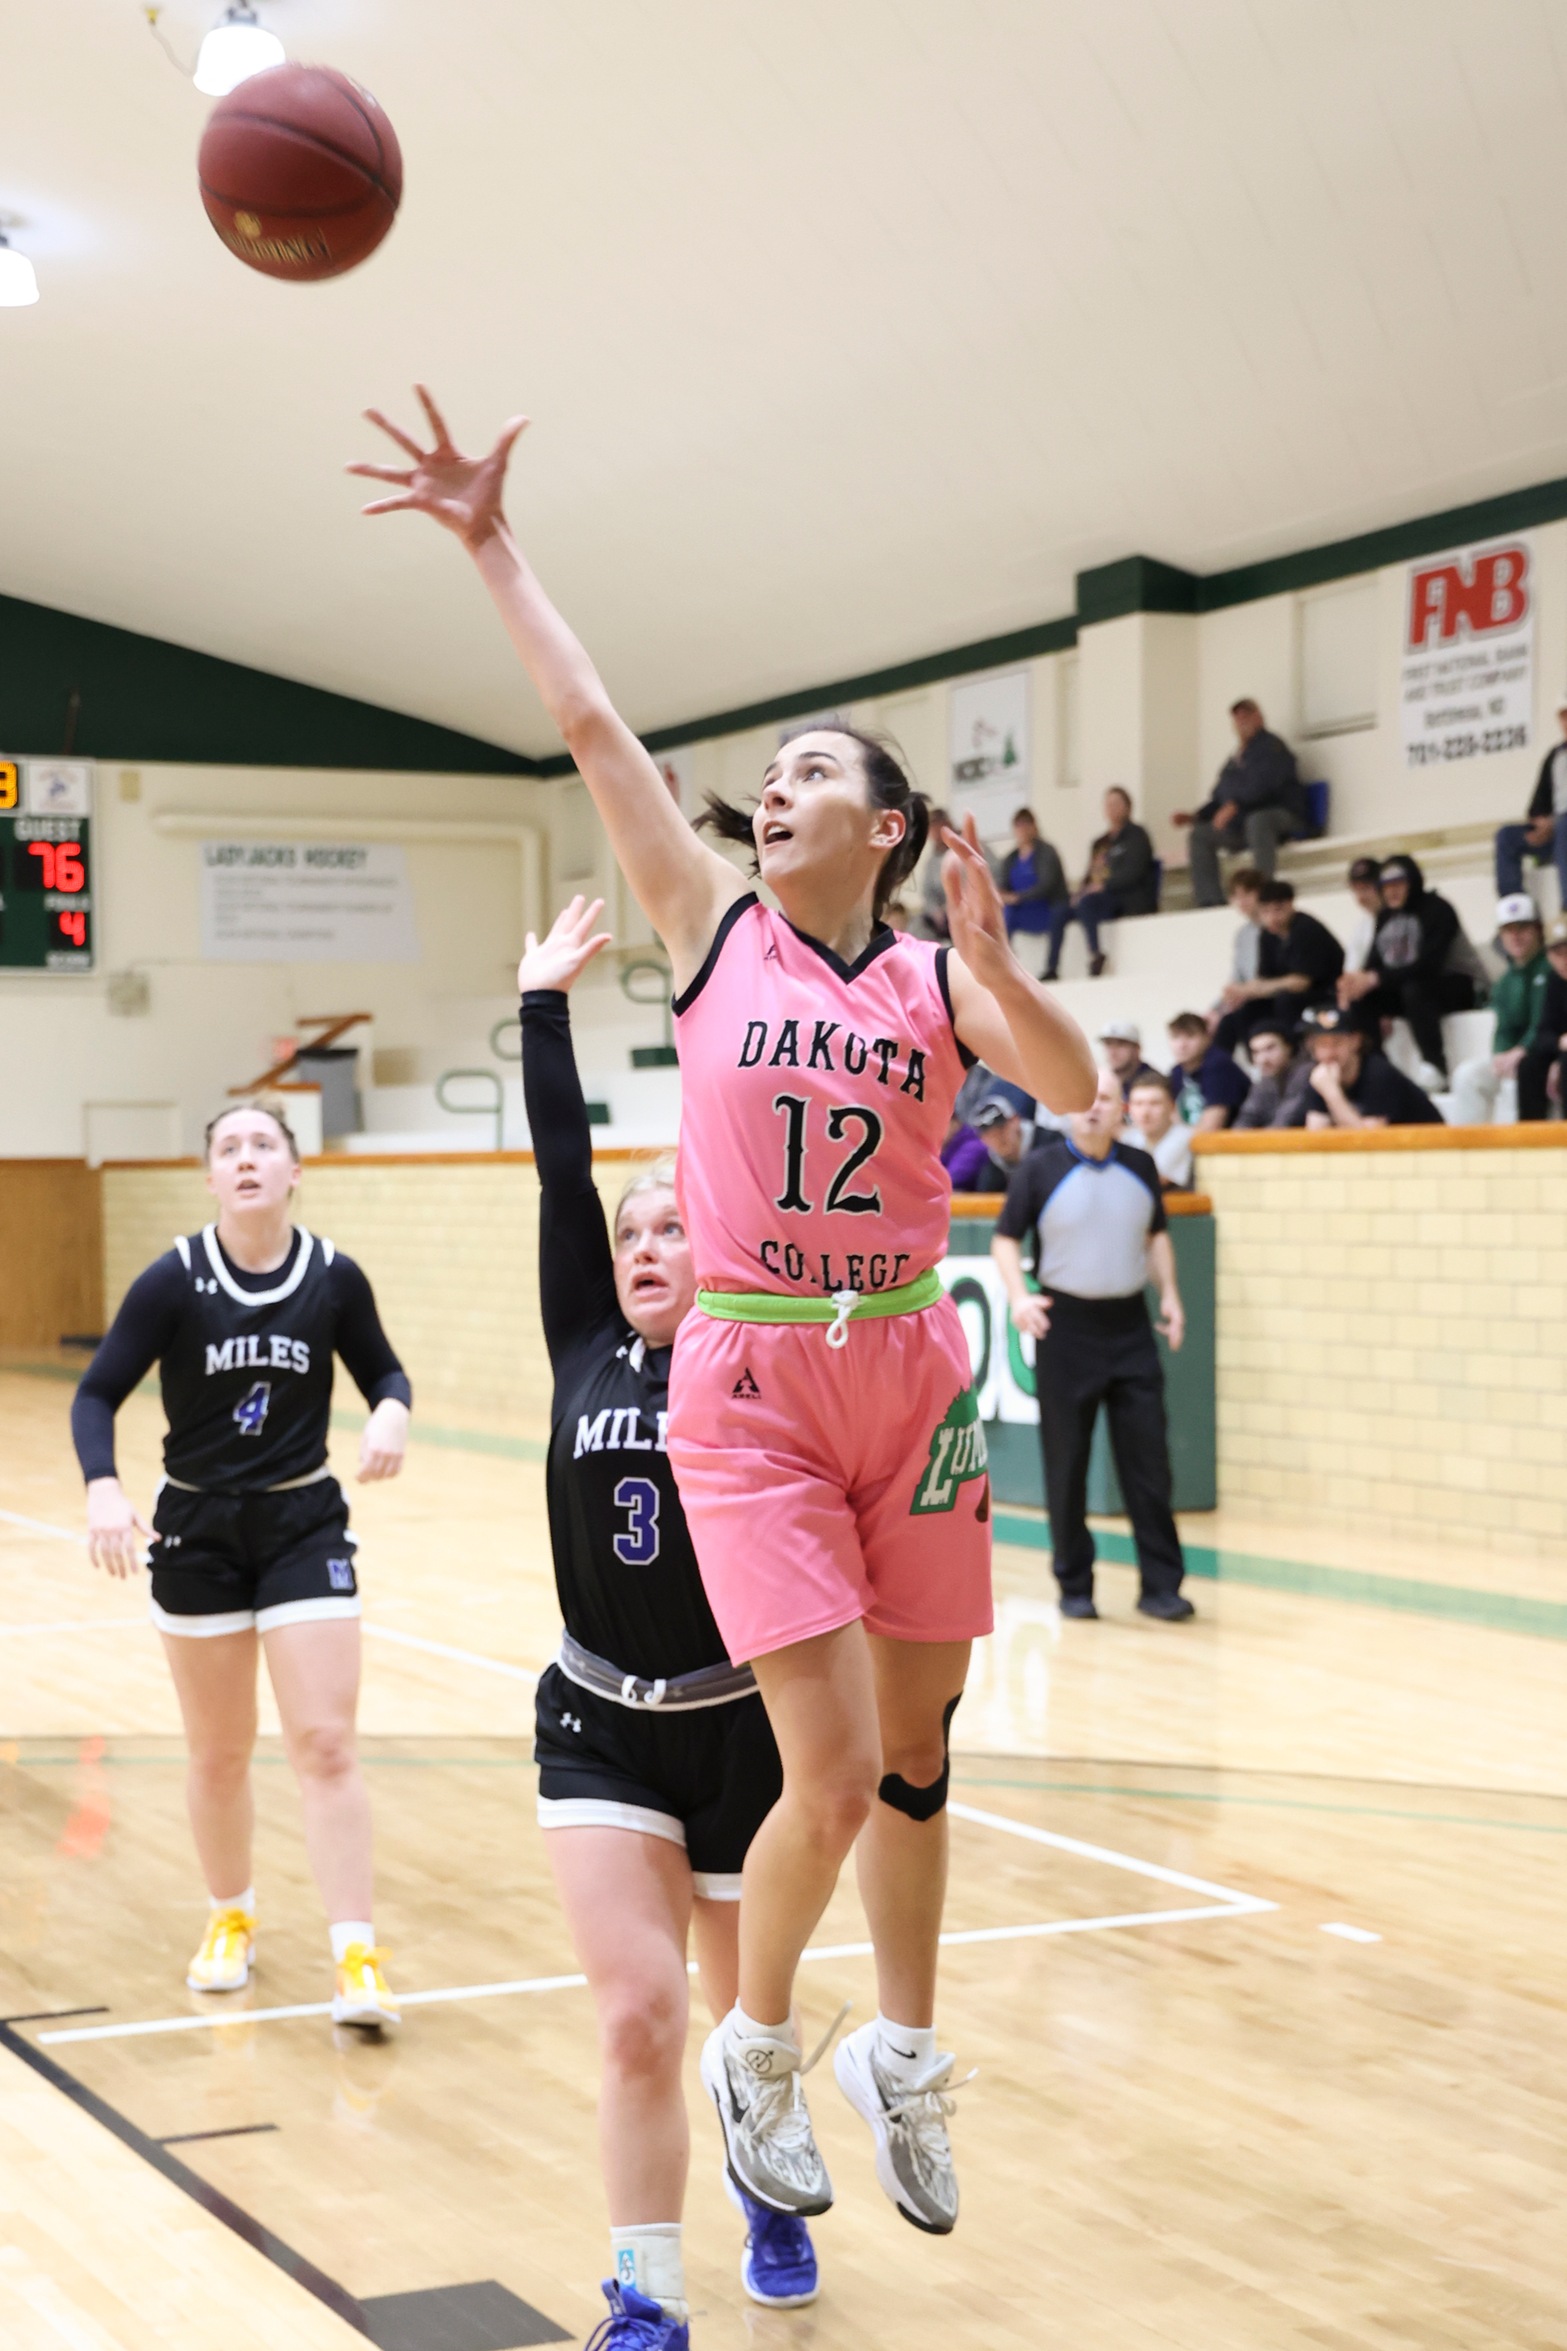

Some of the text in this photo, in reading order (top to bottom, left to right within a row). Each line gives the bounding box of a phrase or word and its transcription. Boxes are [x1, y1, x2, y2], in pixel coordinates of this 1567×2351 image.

[1410, 548, 1528, 647] FNB
[15, 819, 81, 842] GUEST
[28, 841, 85, 893] 76
[304, 846, 368, 871] HOCKEY
[59, 911, 86, 947] 4
[736, 1019, 928, 1103] DAKOTA
[772, 1092, 884, 1217] 12
[759, 1239, 912, 1293] COLEG
[205, 1334, 311, 1376] MILES
[232, 1381, 272, 1436] 4
[613, 1477, 660, 1566] 3
